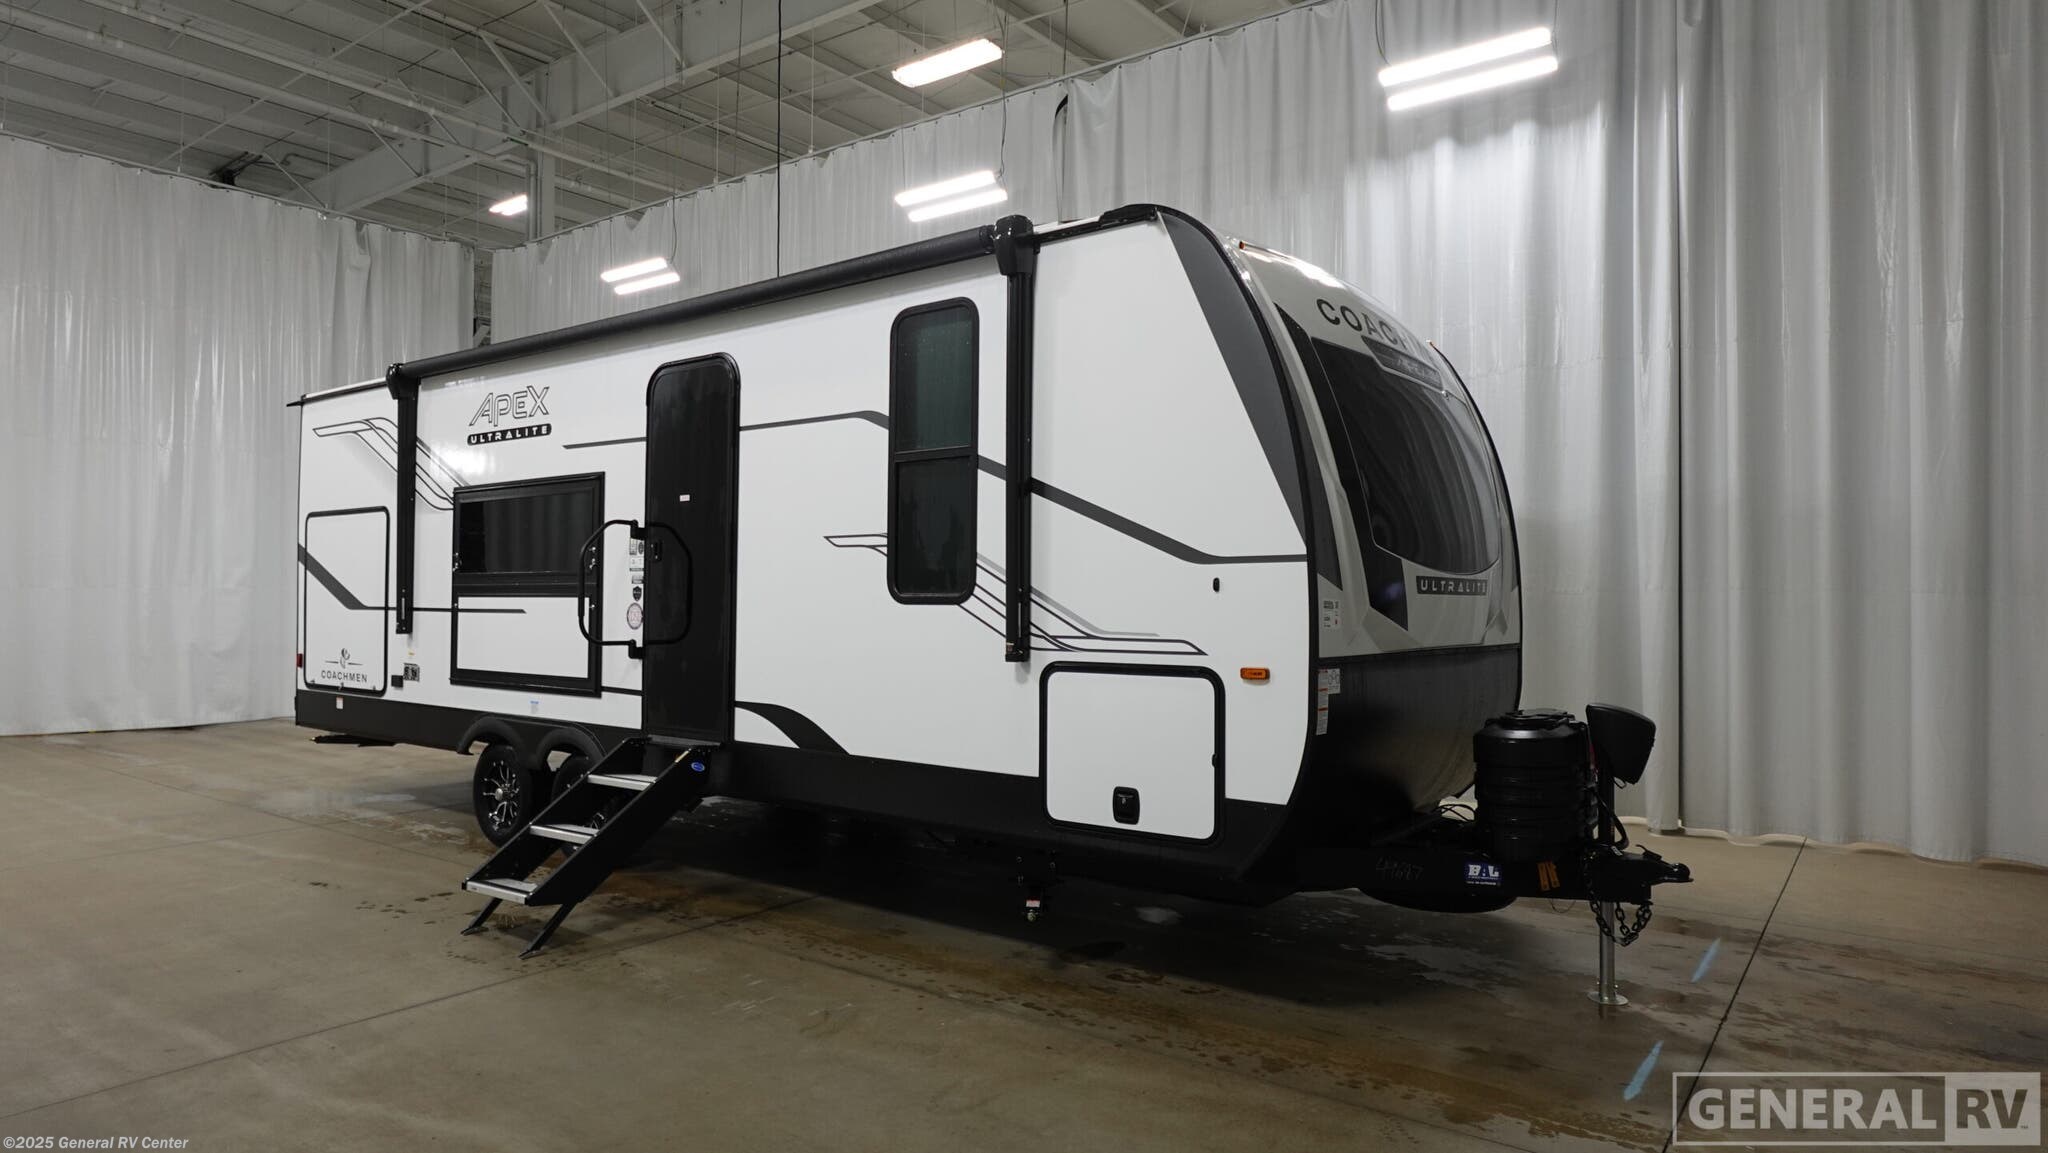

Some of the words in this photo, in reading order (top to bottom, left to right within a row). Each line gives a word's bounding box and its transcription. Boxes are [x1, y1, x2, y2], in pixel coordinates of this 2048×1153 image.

[469, 385, 550, 427] APEX
[469, 424, 549, 444] ULTRALITE
[320, 670, 368, 683] COACHMEN
